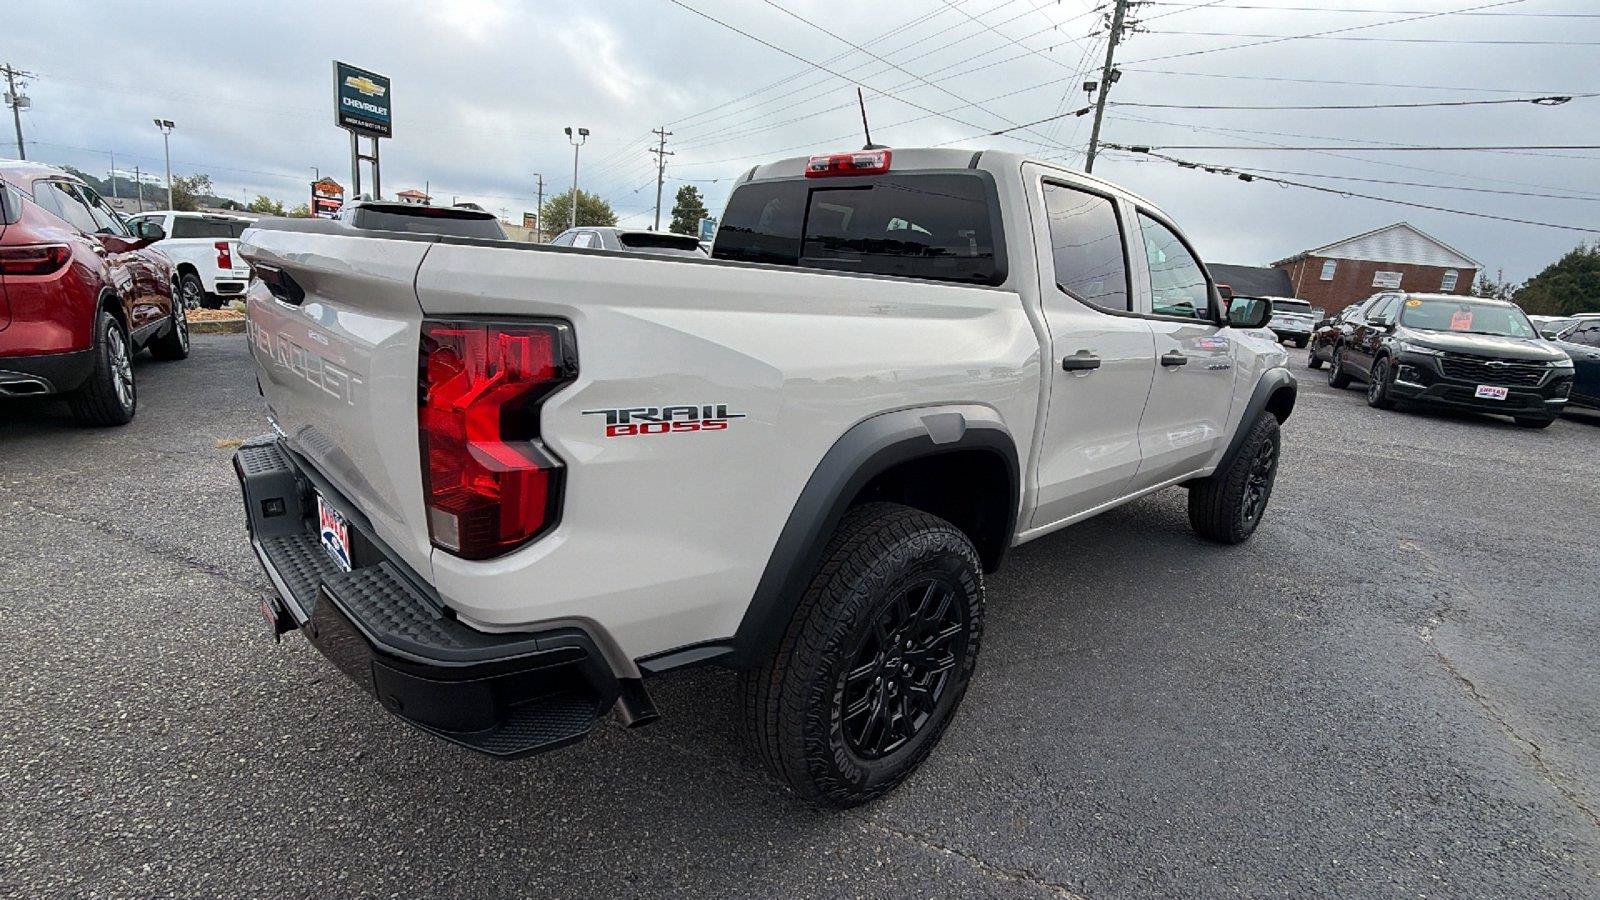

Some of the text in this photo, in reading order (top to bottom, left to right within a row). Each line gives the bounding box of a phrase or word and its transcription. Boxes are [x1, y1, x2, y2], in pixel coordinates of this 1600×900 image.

[342, 97, 388, 116] CHEVROLET
[581, 404, 746, 425] TRAIL
[606, 419, 728, 438] BOSS
